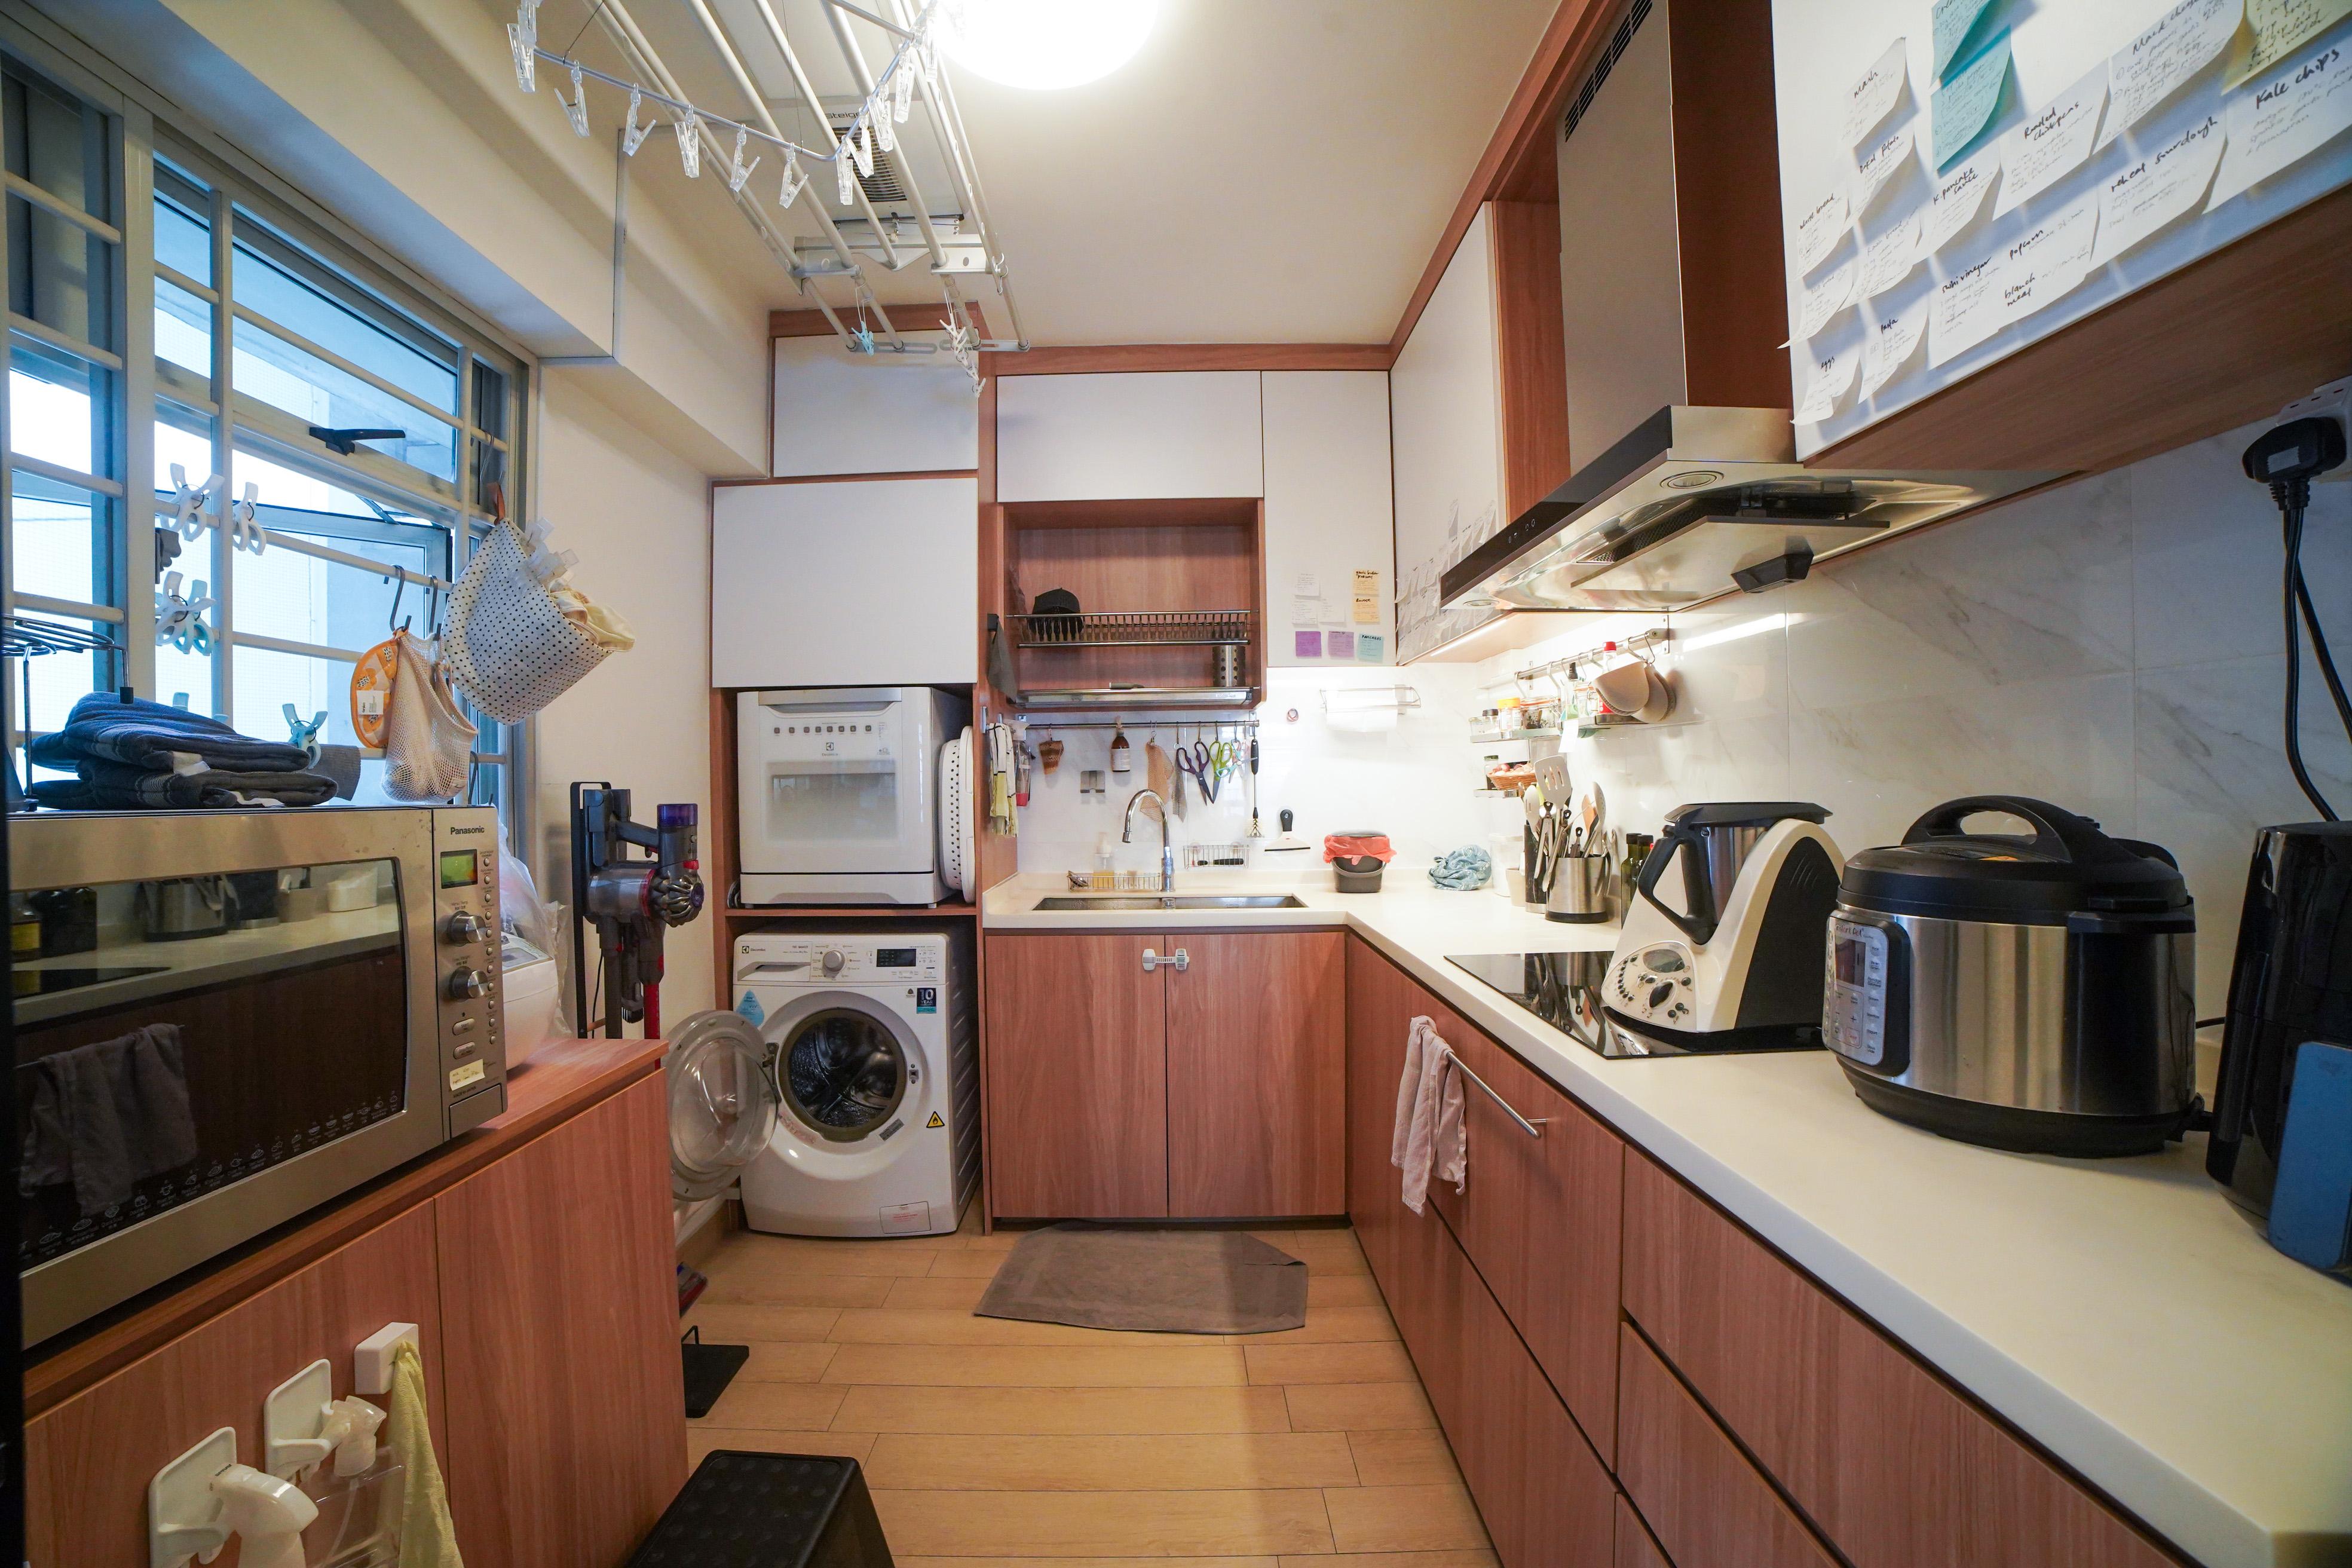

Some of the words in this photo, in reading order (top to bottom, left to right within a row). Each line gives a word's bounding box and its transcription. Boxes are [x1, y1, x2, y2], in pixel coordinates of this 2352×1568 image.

[2295, 49, 2339, 84] chips
[2010, 228, 2044, 260] popcorn
[450, 825, 485, 835] Panasonic
[920, 988, 934, 1000] 10
